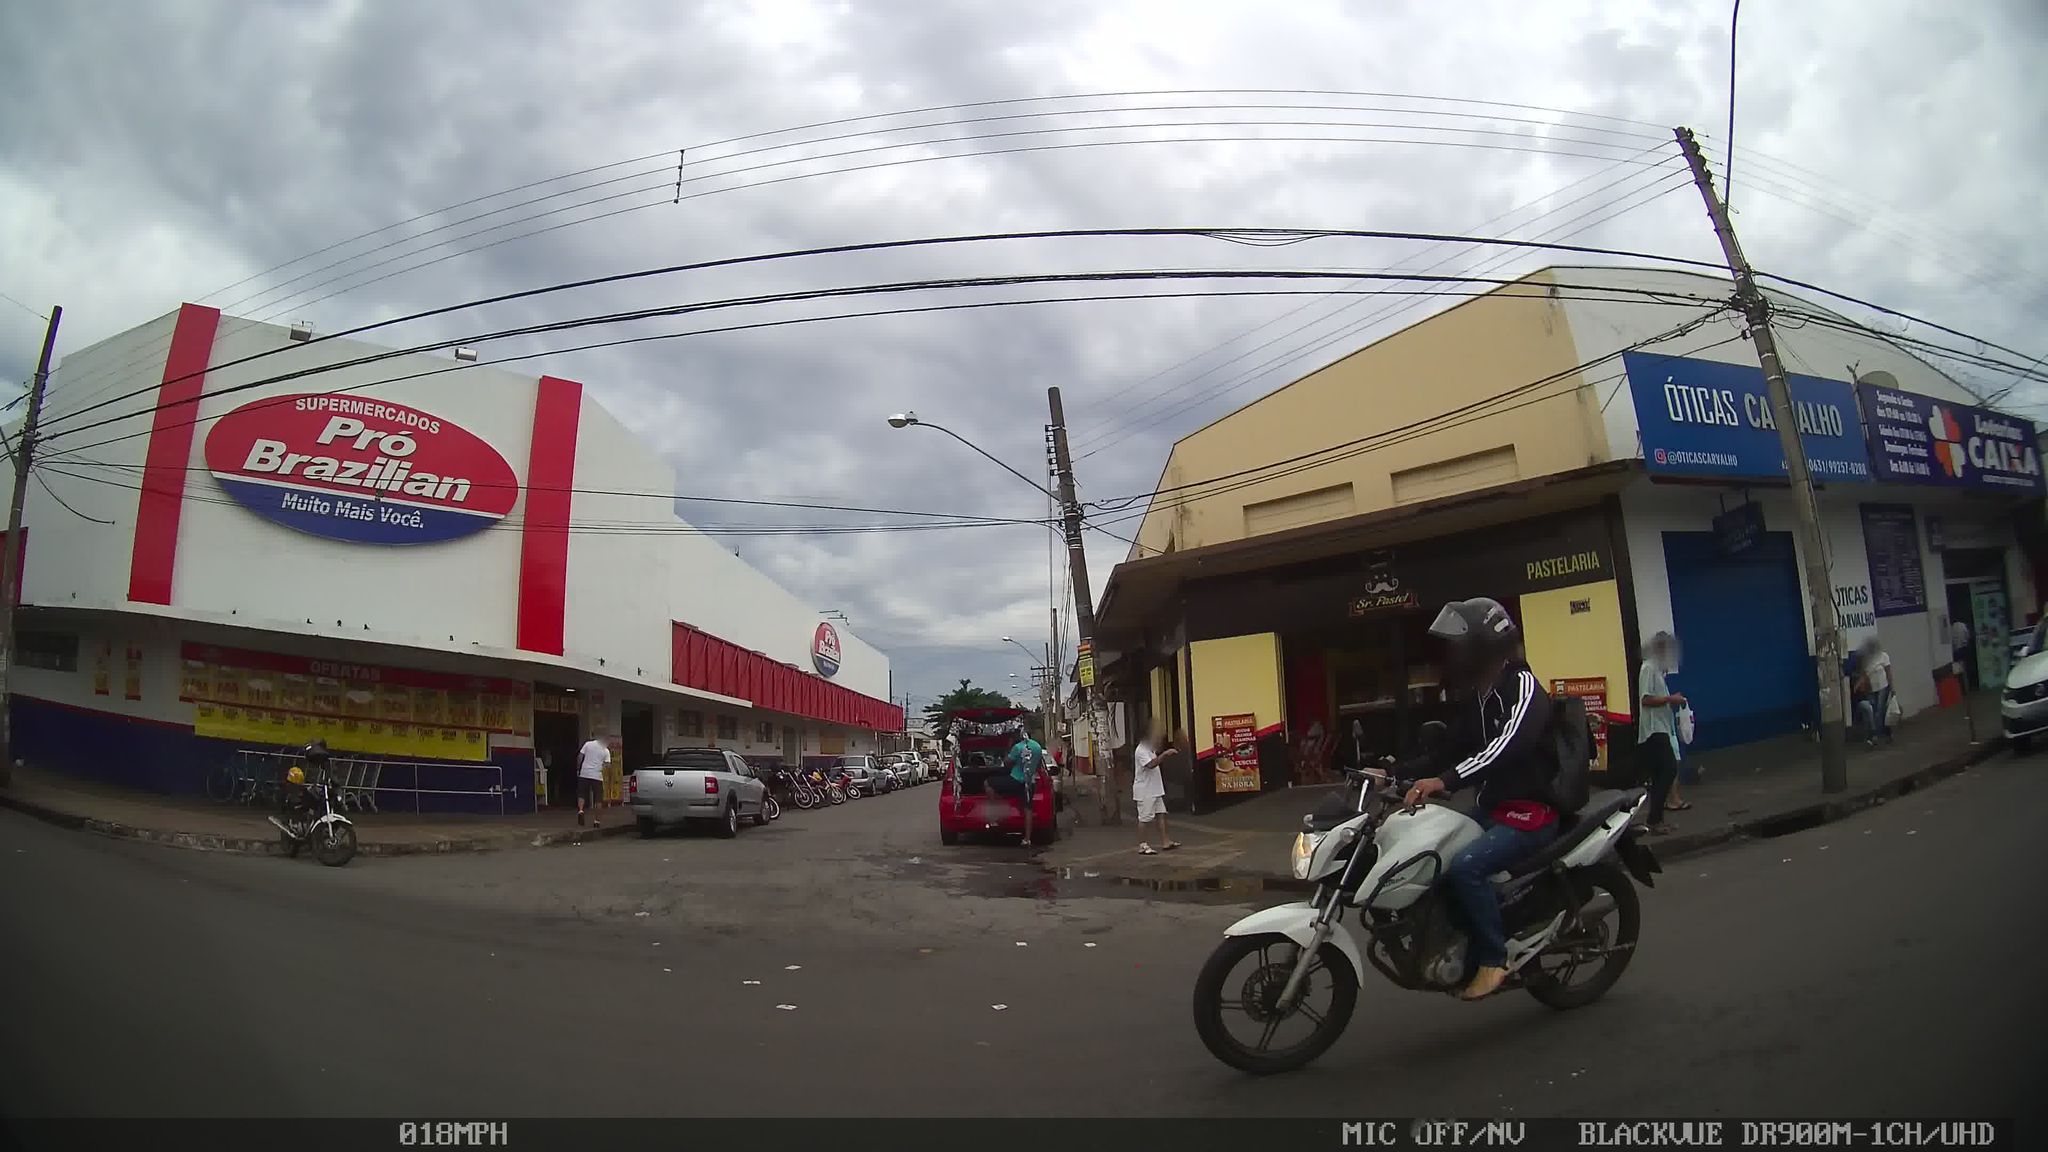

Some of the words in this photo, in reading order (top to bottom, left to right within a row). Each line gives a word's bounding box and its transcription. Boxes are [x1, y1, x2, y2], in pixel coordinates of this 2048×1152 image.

[295, 398, 441, 434] SUPERMERCADOS
[1663, 376, 1739, 426] ÓTICAS
[316, 415, 417, 457] Pró
[242, 439, 472, 502] Brazilian
[281, 493, 330, 515] Muito
[335, 500, 374, 521] Mais
[380, 507, 424, 528] Você.
[1527, 551, 1600, 580] PASTELARIA
[1376, 592, 1409, 606] Pastel
[1839, 612, 1874, 628] ARVALHO
[1567, 683, 1605, 692] PASTELARIA
